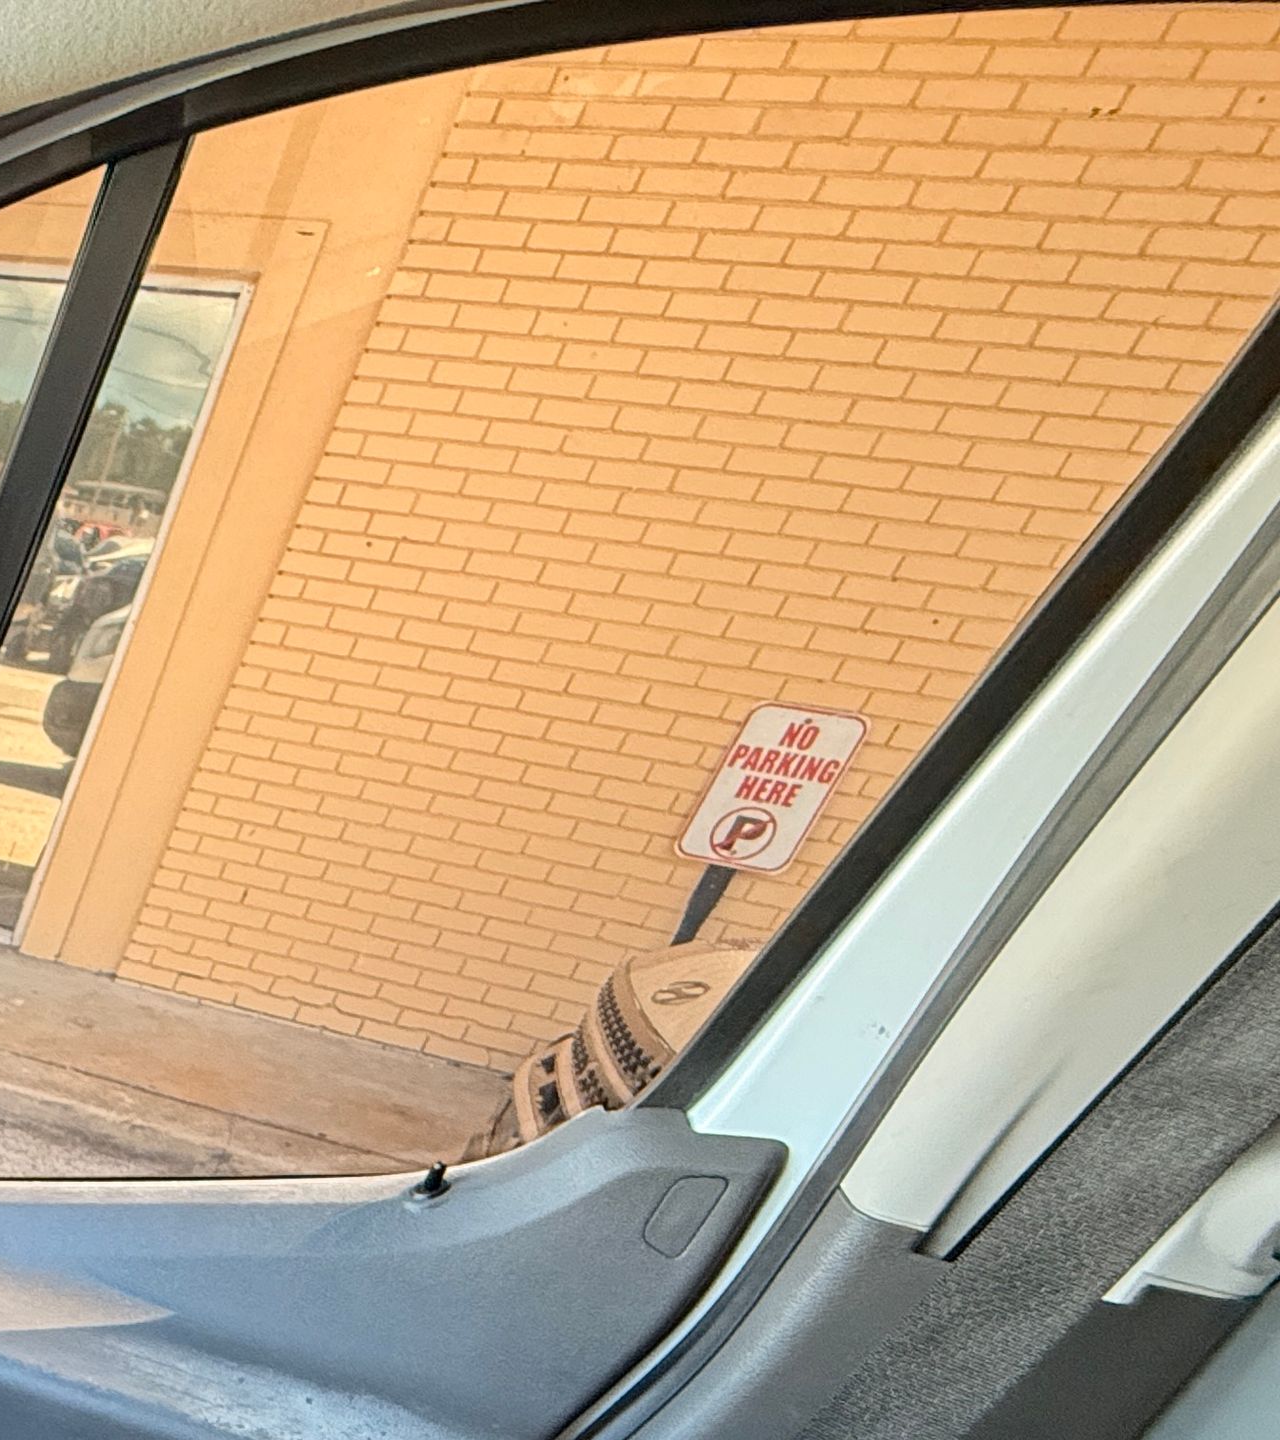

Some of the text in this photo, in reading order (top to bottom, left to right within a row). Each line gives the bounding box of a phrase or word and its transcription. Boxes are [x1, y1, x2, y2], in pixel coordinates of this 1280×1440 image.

[778, 722, 820, 751] NO
[727, 744, 841, 784] PARKING
[734, 775, 803, 807] HERE
